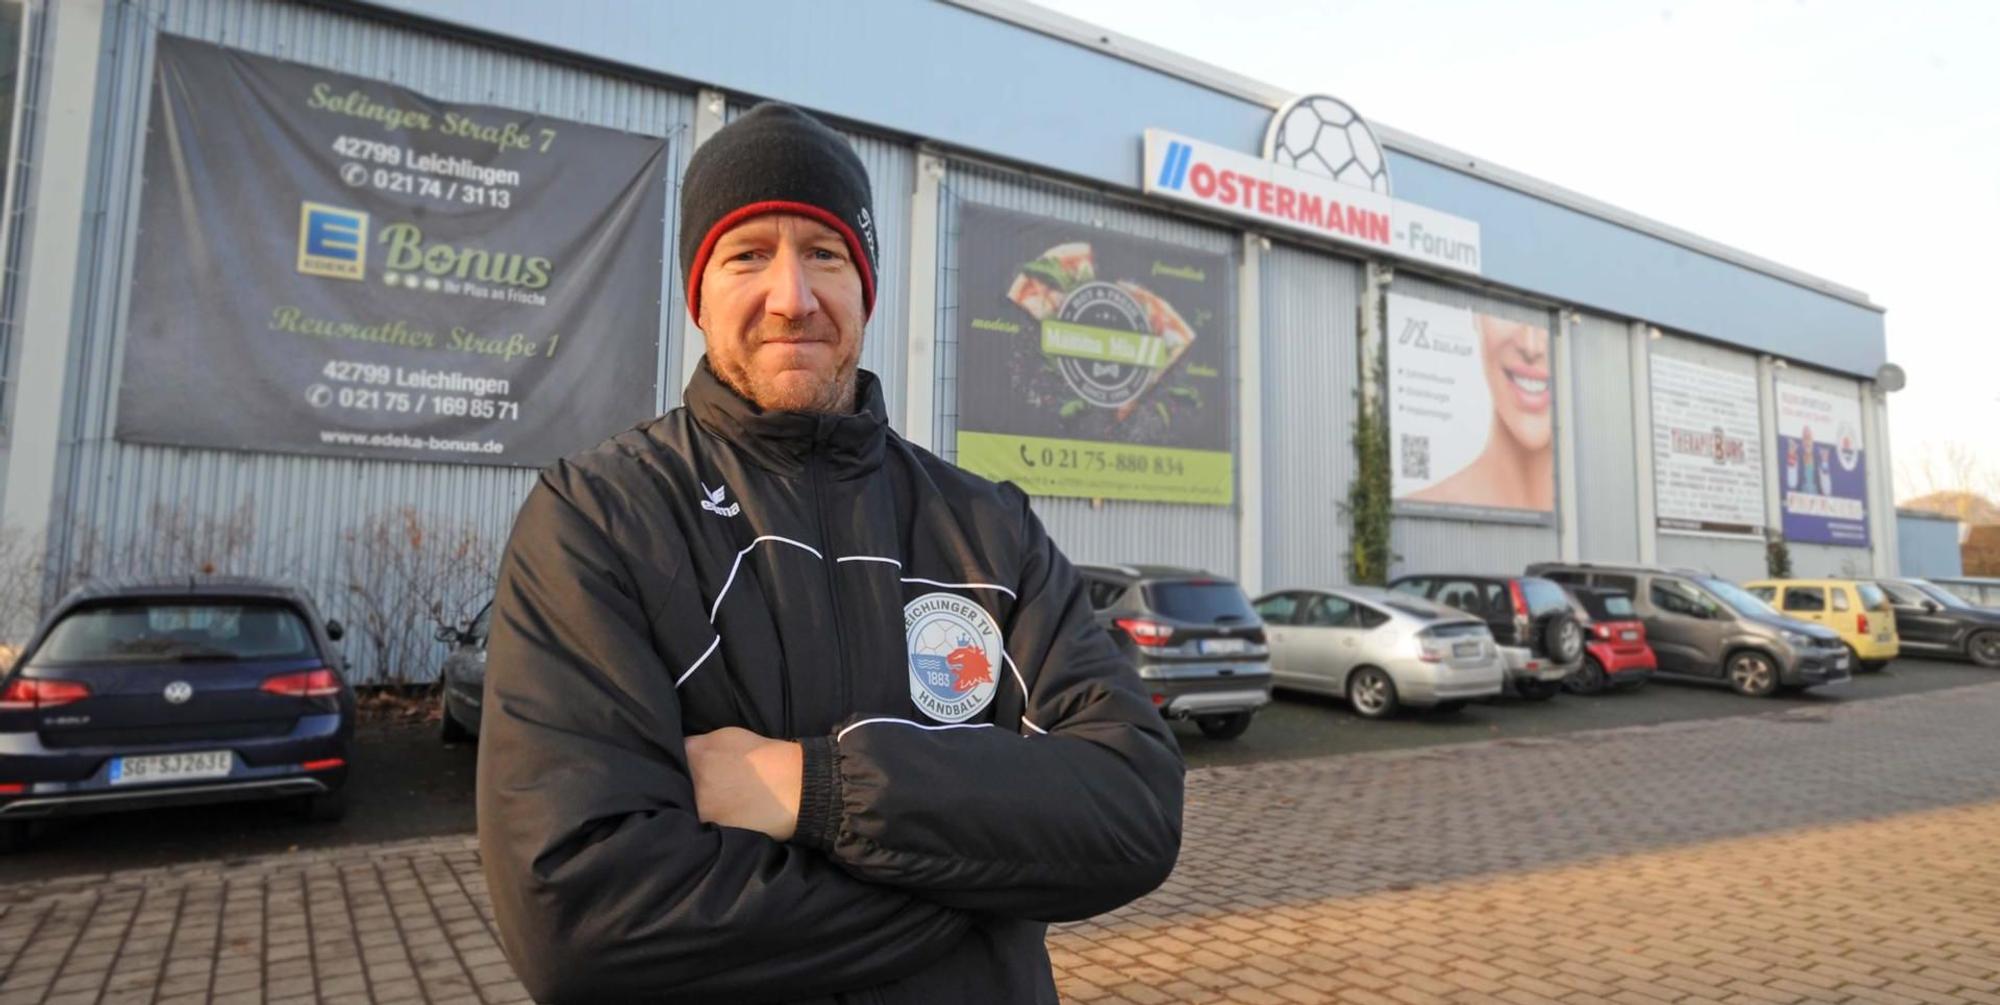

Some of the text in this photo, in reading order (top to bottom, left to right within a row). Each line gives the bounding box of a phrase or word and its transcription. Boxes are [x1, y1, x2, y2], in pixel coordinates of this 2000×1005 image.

[307, 82, 556, 154] Solinger Straße 7
[332, 135, 520, 186] 42799 Leichlingen
[1189, 162, 1390, 245] OSTERMANN
[1408, 221, 1478, 266] Forum
[378, 222, 553, 289] Bonus
[463, 283, 489, 299] Plus
[507, 289, 547, 306] Frische
[446, 326, 537, 362] Straße
[545, 334, 560, 359] 1
[323, 360, 510, 397] 42799 Leichlingen
[319, 430, 504, 454] www.edeka-bonus.de
[905, 600, 993, 636] EICHLINGER TV
[927, 670, 951, 687] 1883
[918, 690, 982, 716] HANDBALL
